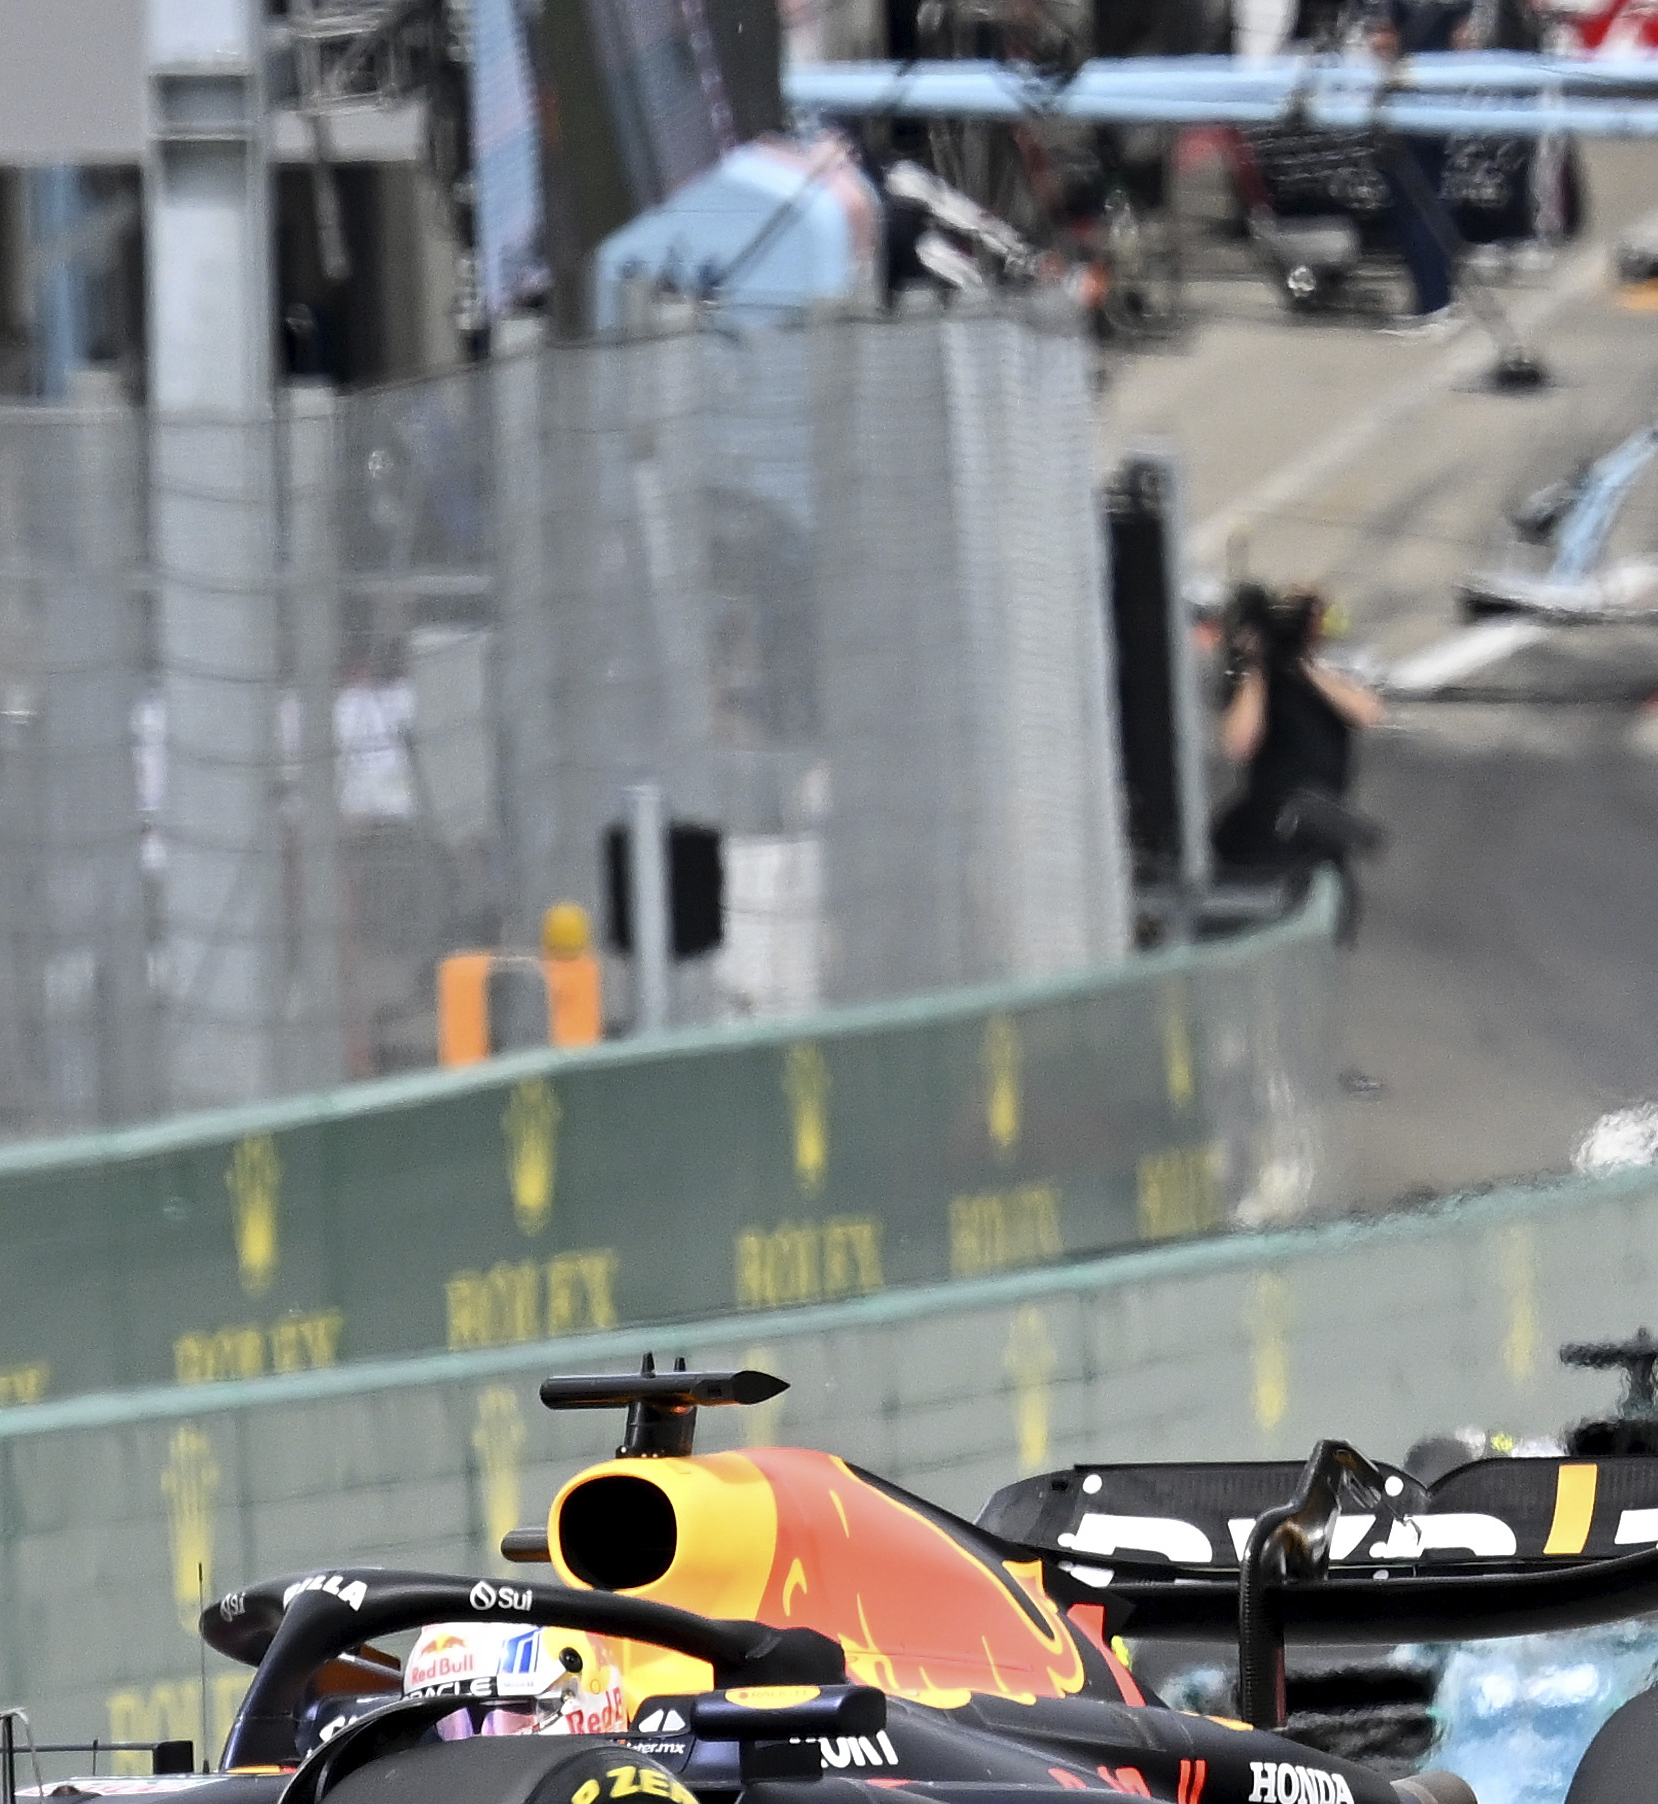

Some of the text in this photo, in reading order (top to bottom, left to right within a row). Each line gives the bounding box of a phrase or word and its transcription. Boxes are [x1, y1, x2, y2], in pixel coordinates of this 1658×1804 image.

[498, 1589, 533, 1612] Sui
[412, 1654, 474, 1685] Red Bull
